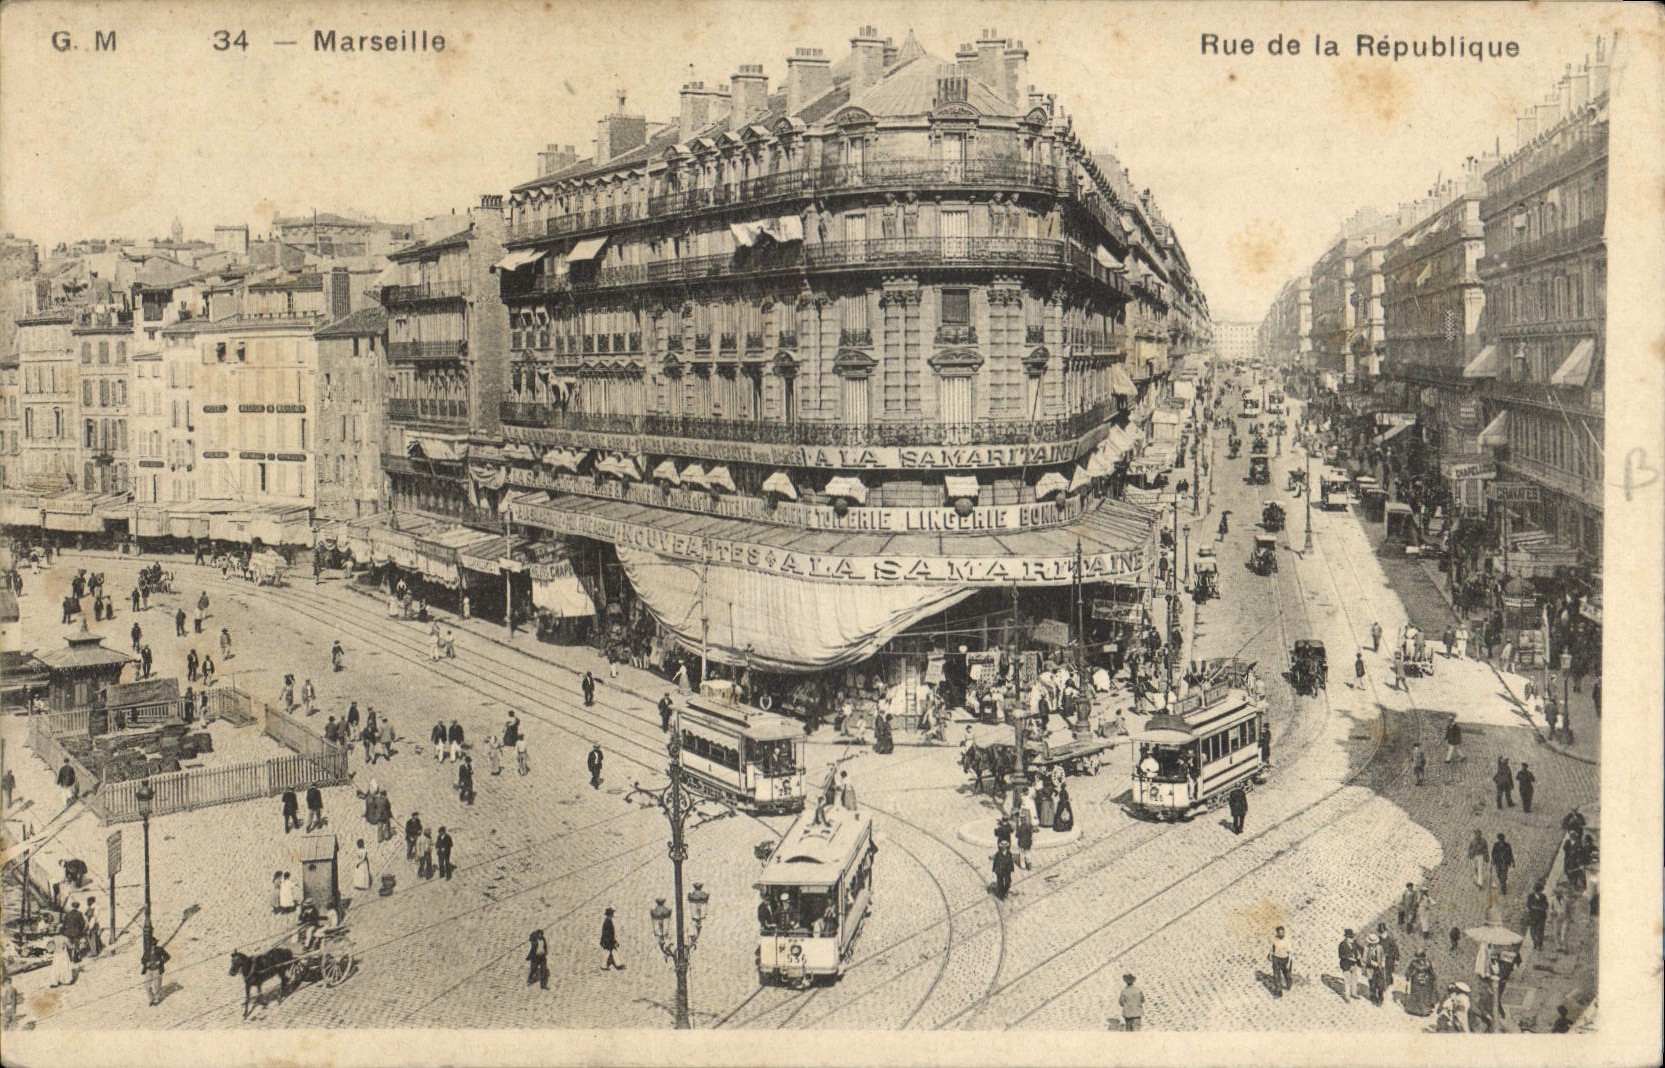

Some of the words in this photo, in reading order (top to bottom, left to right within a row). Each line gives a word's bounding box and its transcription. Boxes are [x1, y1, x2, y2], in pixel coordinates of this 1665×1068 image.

[839, 449, 887, 468] LA
[901, 441, 1074, 468] SAMARITAINE
[906, 509, 1008, 530] LINGERIE
[621, 522, 760, 567] NOUVEAUTES
[808, 556, 867, 581] LA
[873, 550, 1144, 582] SAMARITAINE
